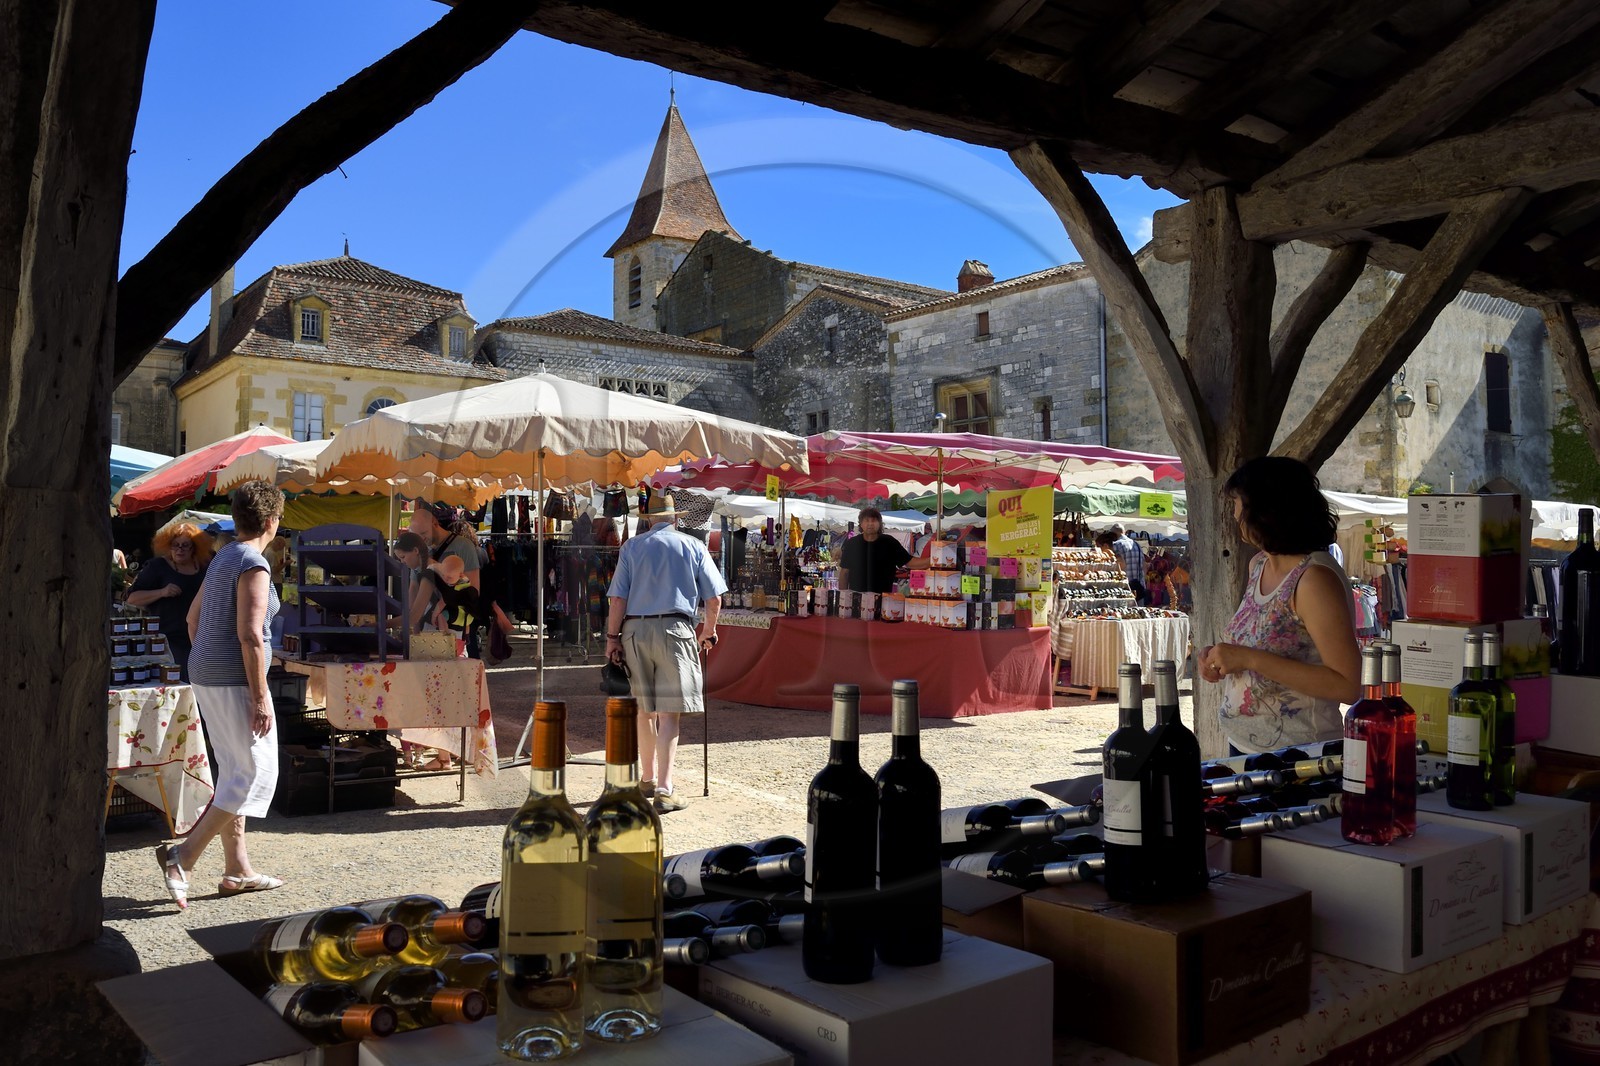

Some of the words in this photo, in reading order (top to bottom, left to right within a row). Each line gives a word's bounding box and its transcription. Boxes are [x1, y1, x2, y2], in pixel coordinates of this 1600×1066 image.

[999, 495, 1022, 516] QUI
[716, 985, 758, 1012] BERGERAC
[1208, 973, 1252, 1002] Domaine
[817, 1026, 837, 1043] CRD
